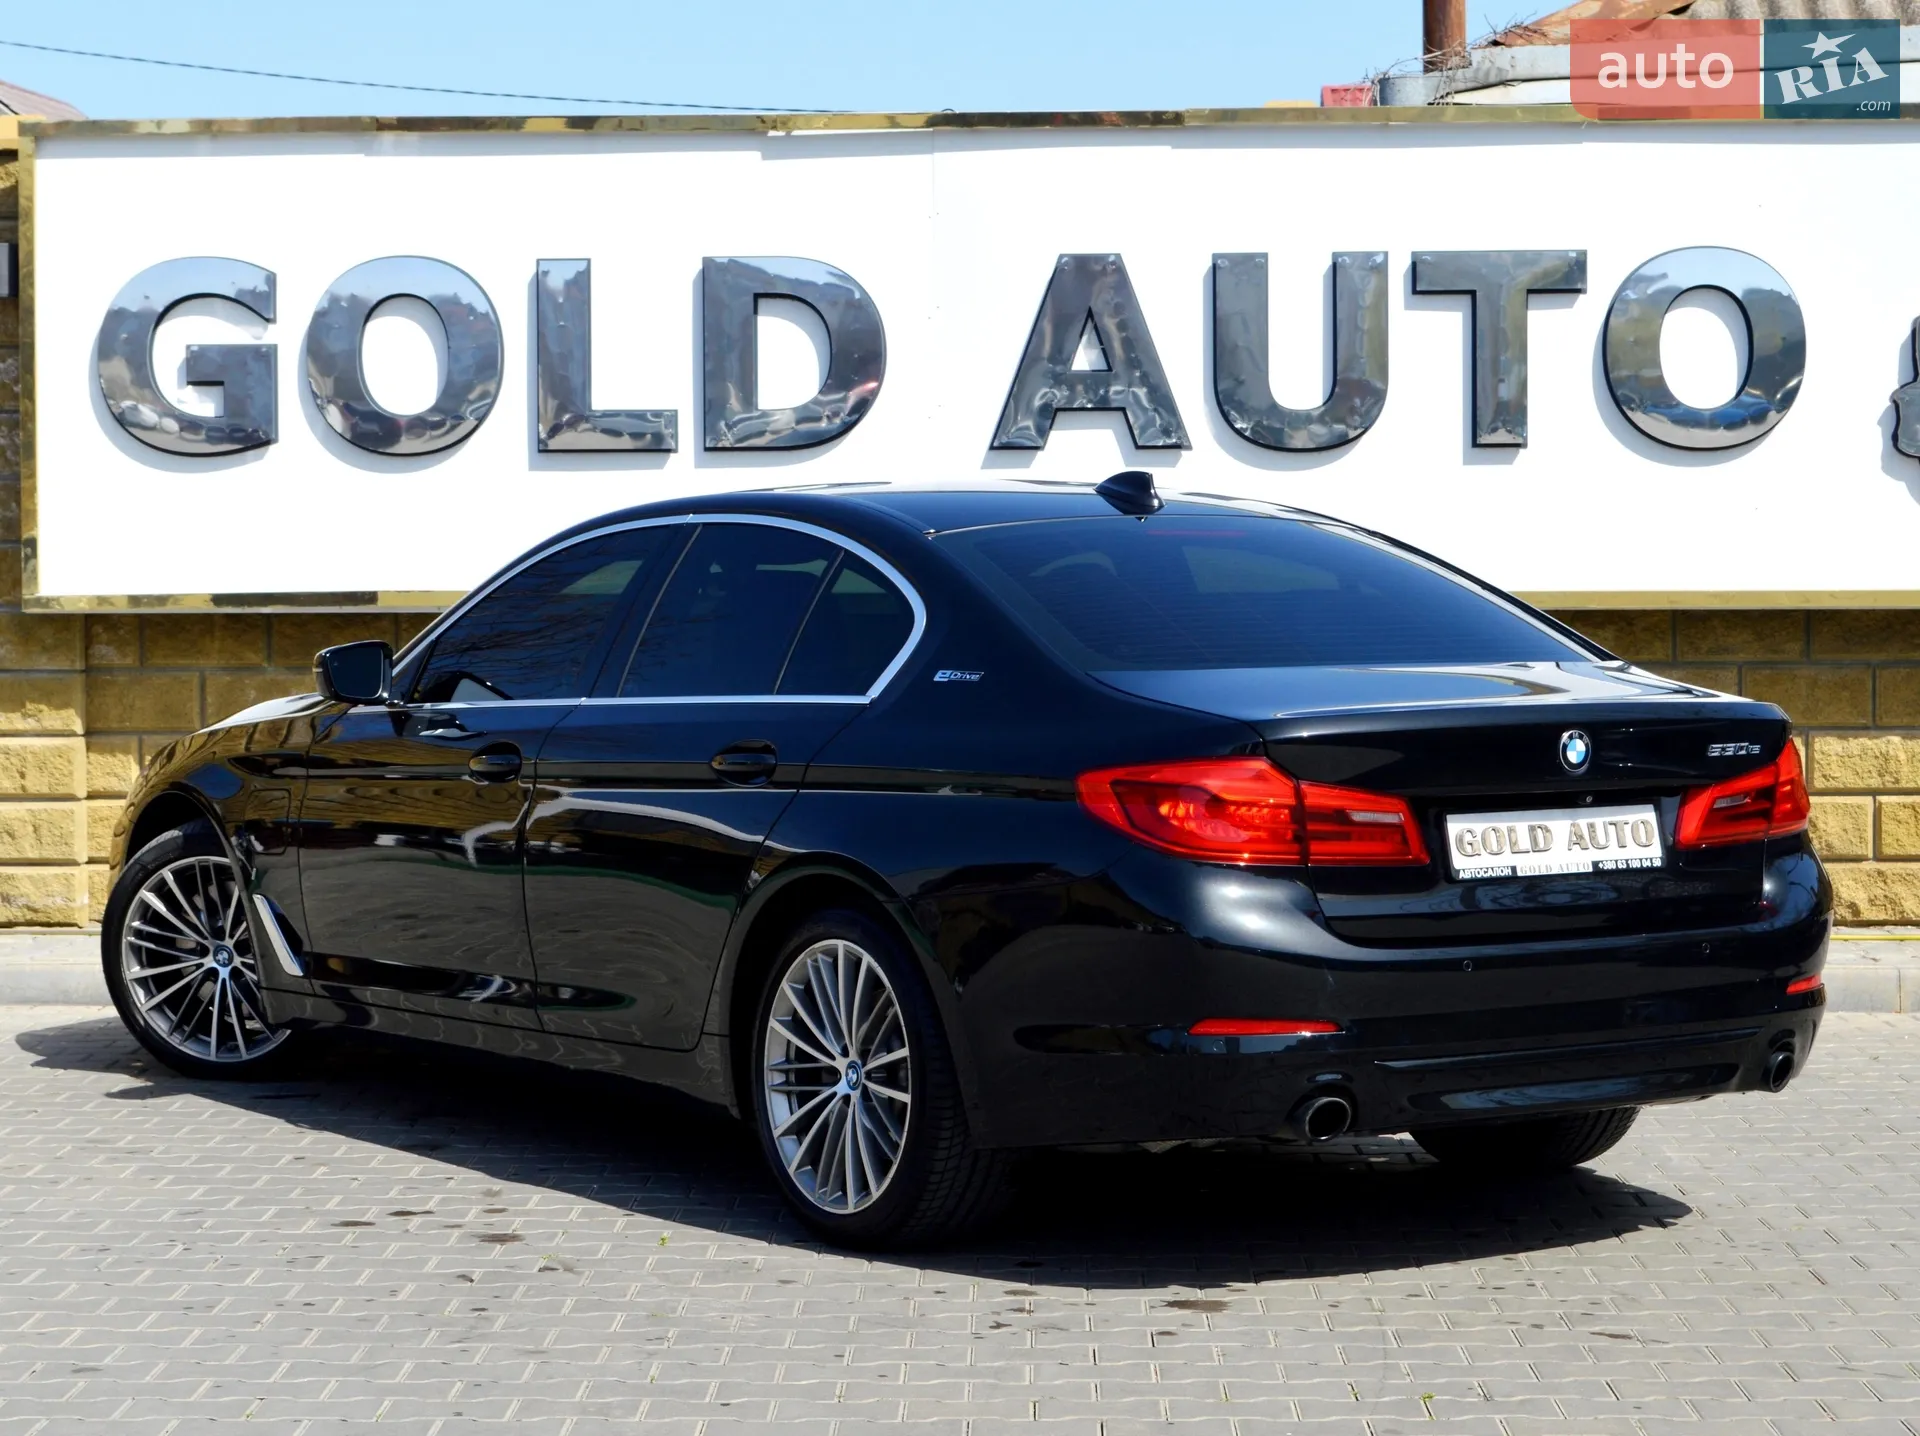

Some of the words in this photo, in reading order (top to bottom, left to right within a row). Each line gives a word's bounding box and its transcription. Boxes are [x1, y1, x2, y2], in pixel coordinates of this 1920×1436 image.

[97, 255, 887, 458] GOLD
[988, 246, 1807, 452] AUTO
[933, 669, 984, 682] eDrive
[1454, 823, 1554, 857] GOLD
[1567, 818, 1656, 851] AUTO
[1519, 864, 1553, 875] GOLD
[1557, 861, 1590, 873] AUTO
[1598, 860, 1616, 870] +380
[1617, 859, 1627, 869] 63
[1628, 858, 1641, 868] 100
[1642, 858, 1652, 867] 04
[1653, 857, 1662, 867] 50
[1458, 866, 1512, 879] АВТОСАЛОН
